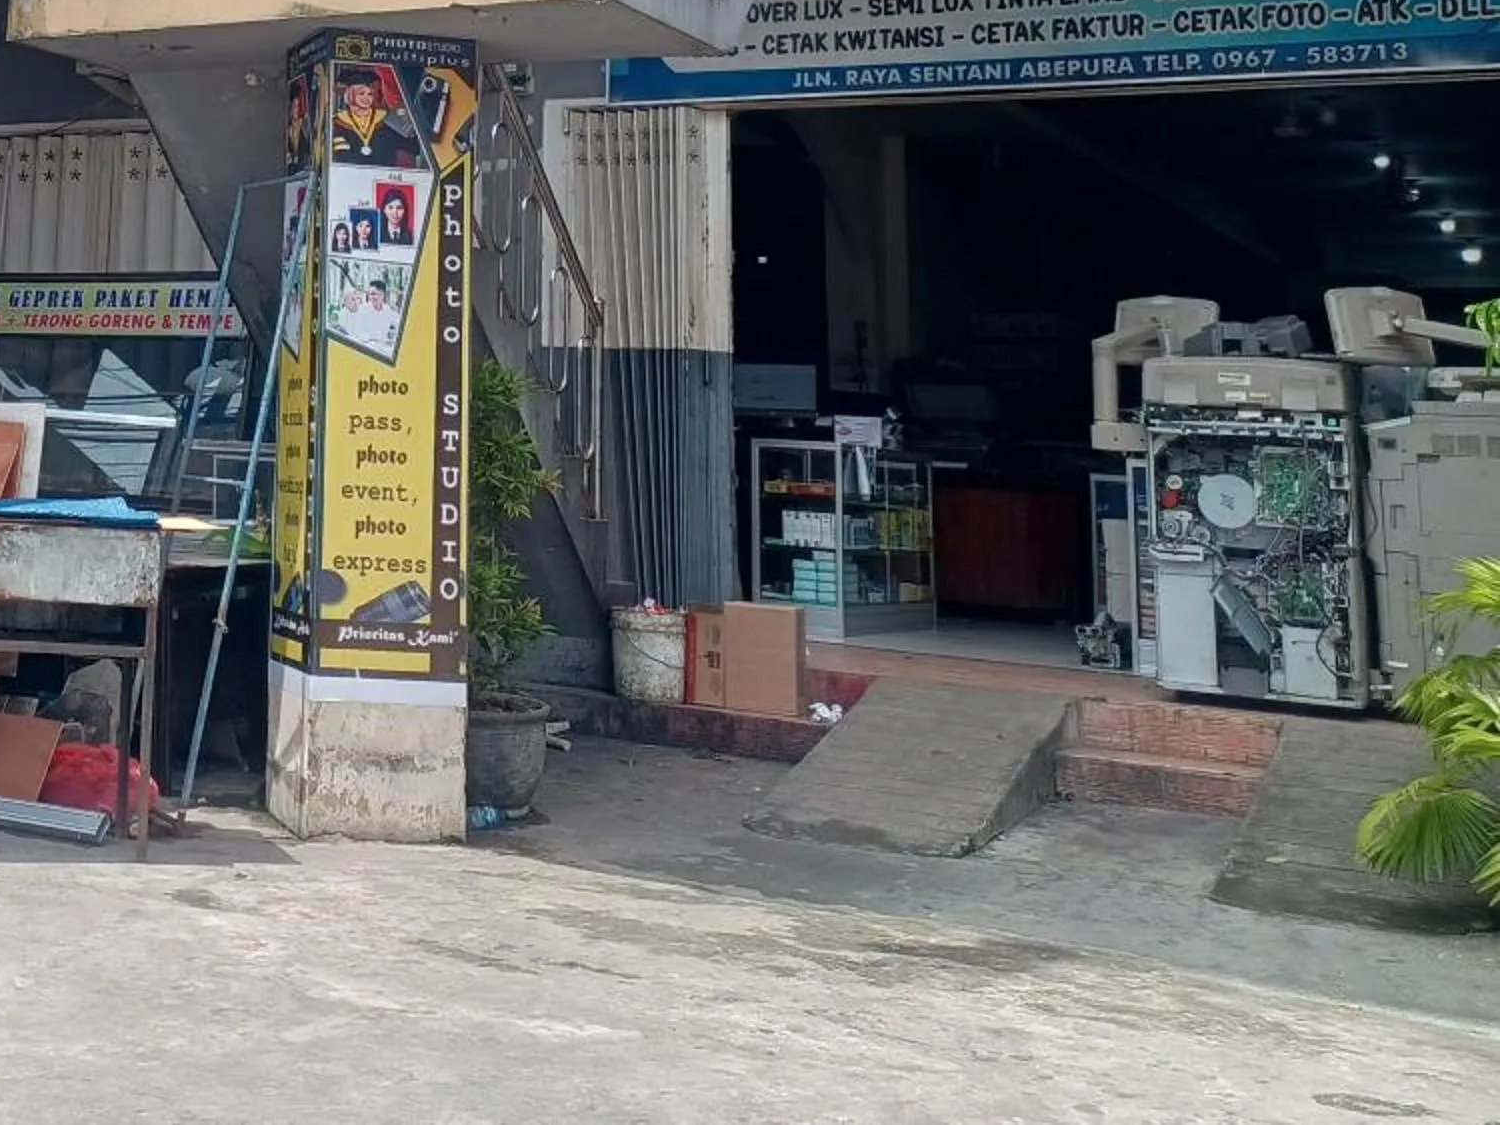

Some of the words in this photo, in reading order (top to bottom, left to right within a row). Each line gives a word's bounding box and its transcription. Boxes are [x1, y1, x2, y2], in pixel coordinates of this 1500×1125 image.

[746, 1, 797, 23] OVER
[804, 0, 843, 21] LUX
[762, 32, 828, 55] CETAK
[835, 24, 945, 52] KWITANSI
[972, 23, 1045, 45] CETAK
[1052, 15, 1145, 42] FAKTUR
[1174, 7, 1253, 34] CETAK
[1261, 1, 1325, 28] FOTO
[373, 49, 471, 69] multiplus
[792, 71, 839, 89] JLN.
[845, 67, 903, 87] RAYA
[908, 60, 1013, 85] SENTANI
[1019, 54, 1135, 78] ABEPURA
[1143, 53, 1203, 74] TELP.
[1212, 48, 1277, 70] 0967
[1307, 42, 1409, 65] 583713
[442, 183, 464, 344] photo
[9, 289, 84, 308] GEPREK
[95, 289, 159, 308] PAKET
[168, 289, 235, 308] HEM
[24, 313, 84, 329] TERONG
[89, 313, 156, 329] GORENG
[162, 314, 172, 329] &
[179, 314, 234, 330] TEME
[357, 374, 409, 399] photo
[349, 413, 412, 436] pass,
[356, 444, 408, 469] photo
[341, 483, 418, 507] event,
[440, 394, 460, 600] STUDIO
[355, 515, 407, 539] photo
[333, 553, 428, 576] express
[337, 626, 405, 645] Prioritas
